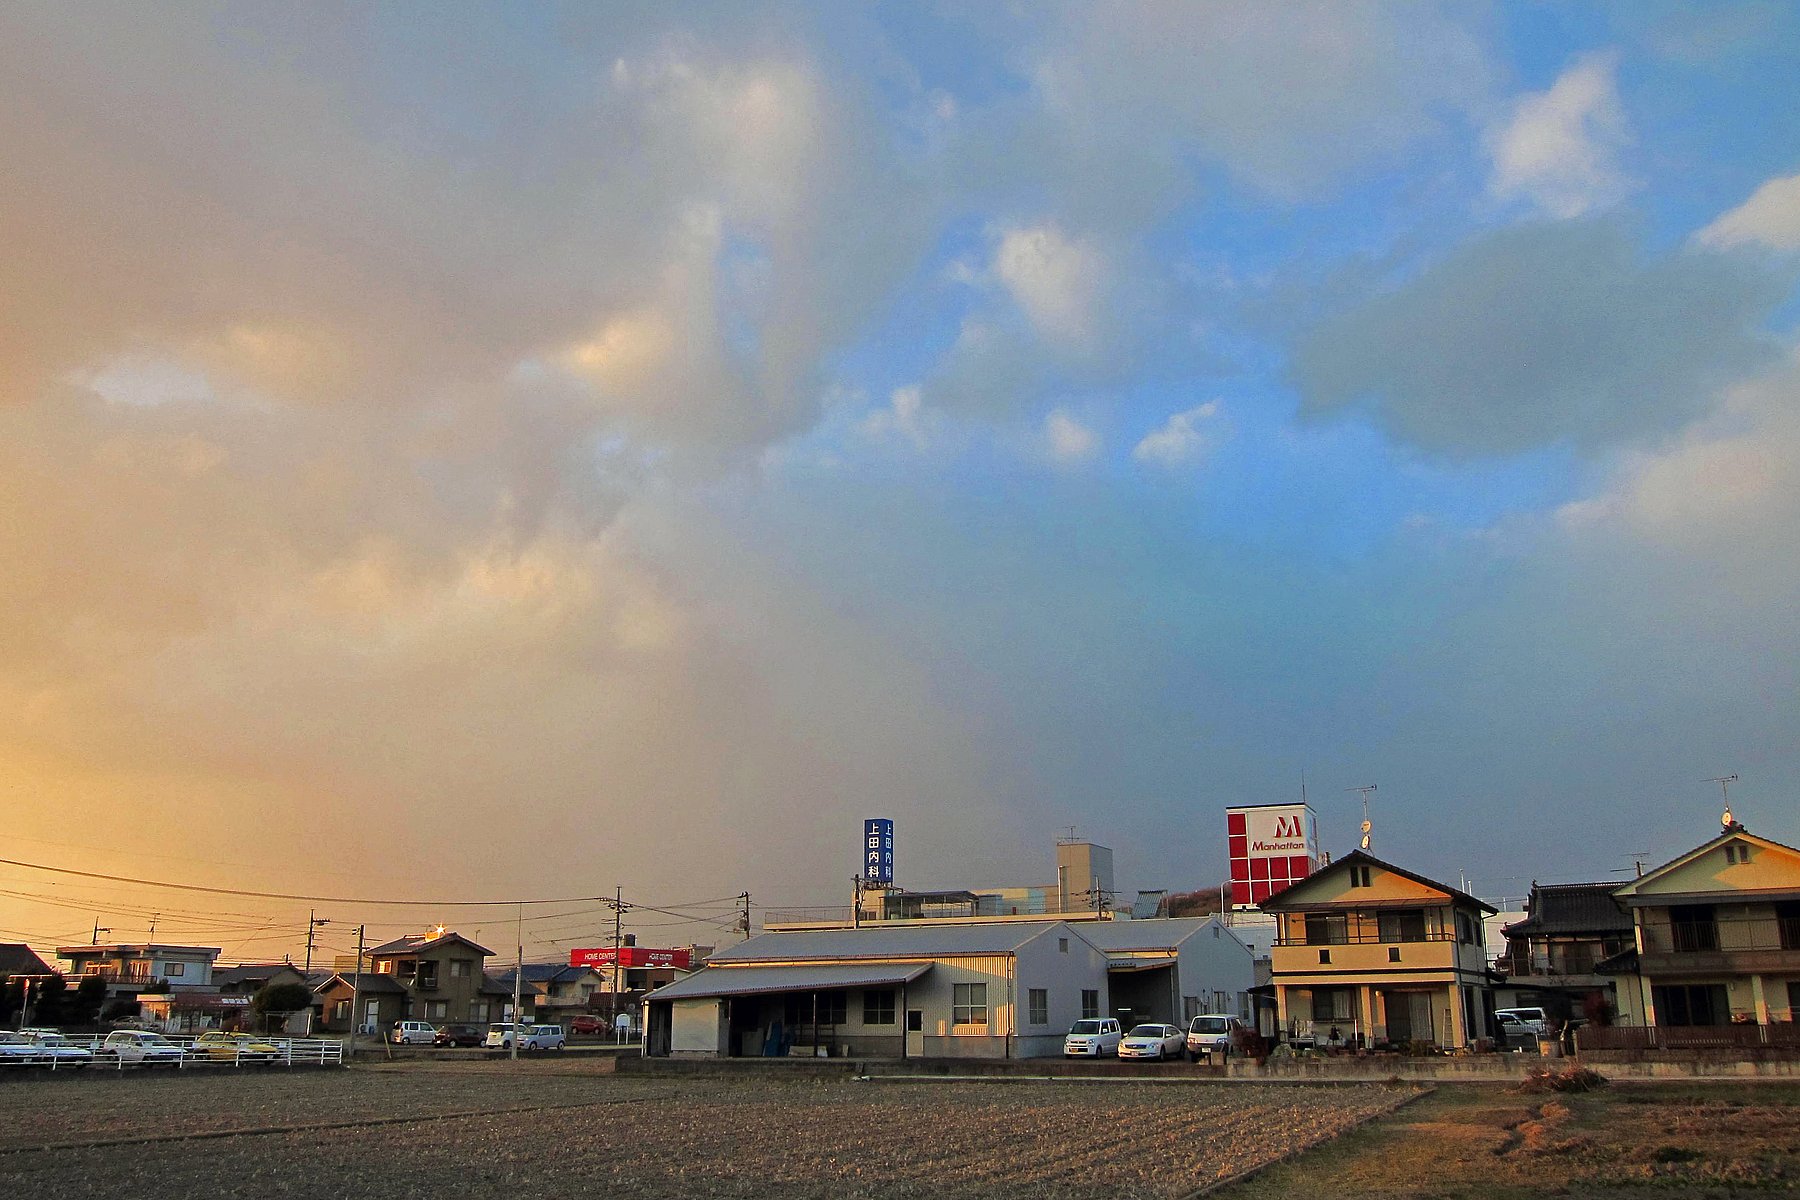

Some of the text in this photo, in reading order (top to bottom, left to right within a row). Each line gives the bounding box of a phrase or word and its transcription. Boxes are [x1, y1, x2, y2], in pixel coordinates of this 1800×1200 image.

[868, 822, 880, 878] 上田内科
[1251, 841, 1304, 852] Manhattan
[584, 952, 598, 960] HOME
